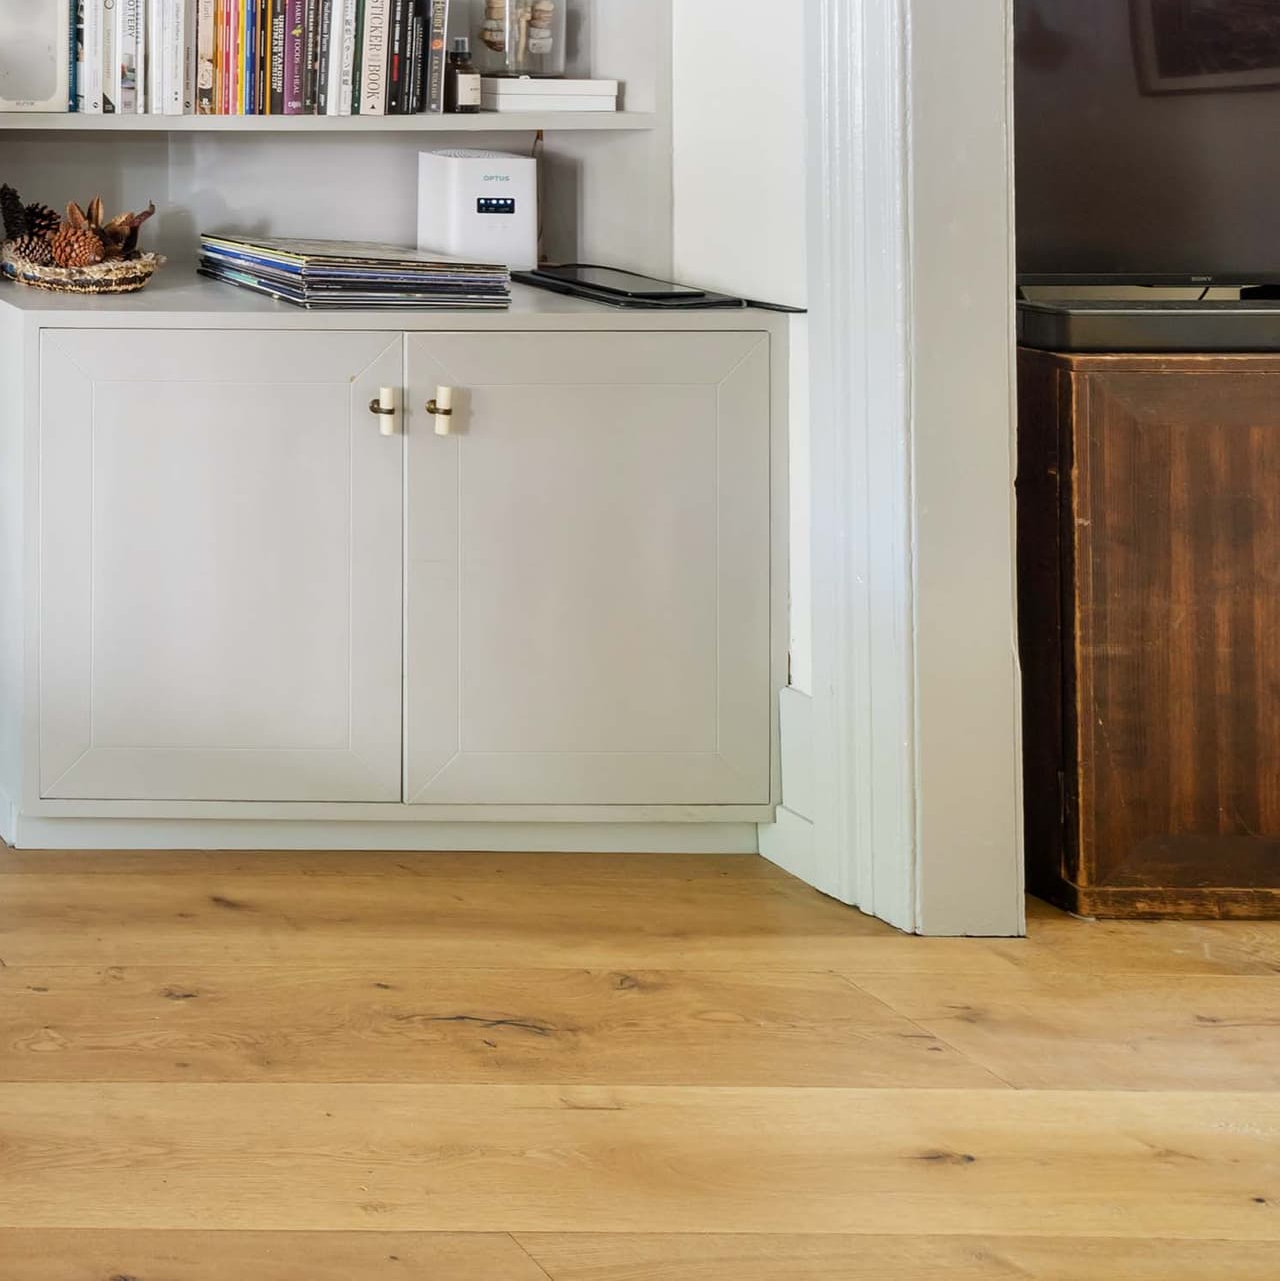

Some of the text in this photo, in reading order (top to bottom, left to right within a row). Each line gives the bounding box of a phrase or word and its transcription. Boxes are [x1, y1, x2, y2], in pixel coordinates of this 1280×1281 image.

[294, 0, 302, 25] HARM
[276, 14, 284, 93] UNDERSTANDING
[293, 38, 301, 64] FOODS
[293, 74, 301, 95] HEAL
[366, 63, 381, 101] BOOK
